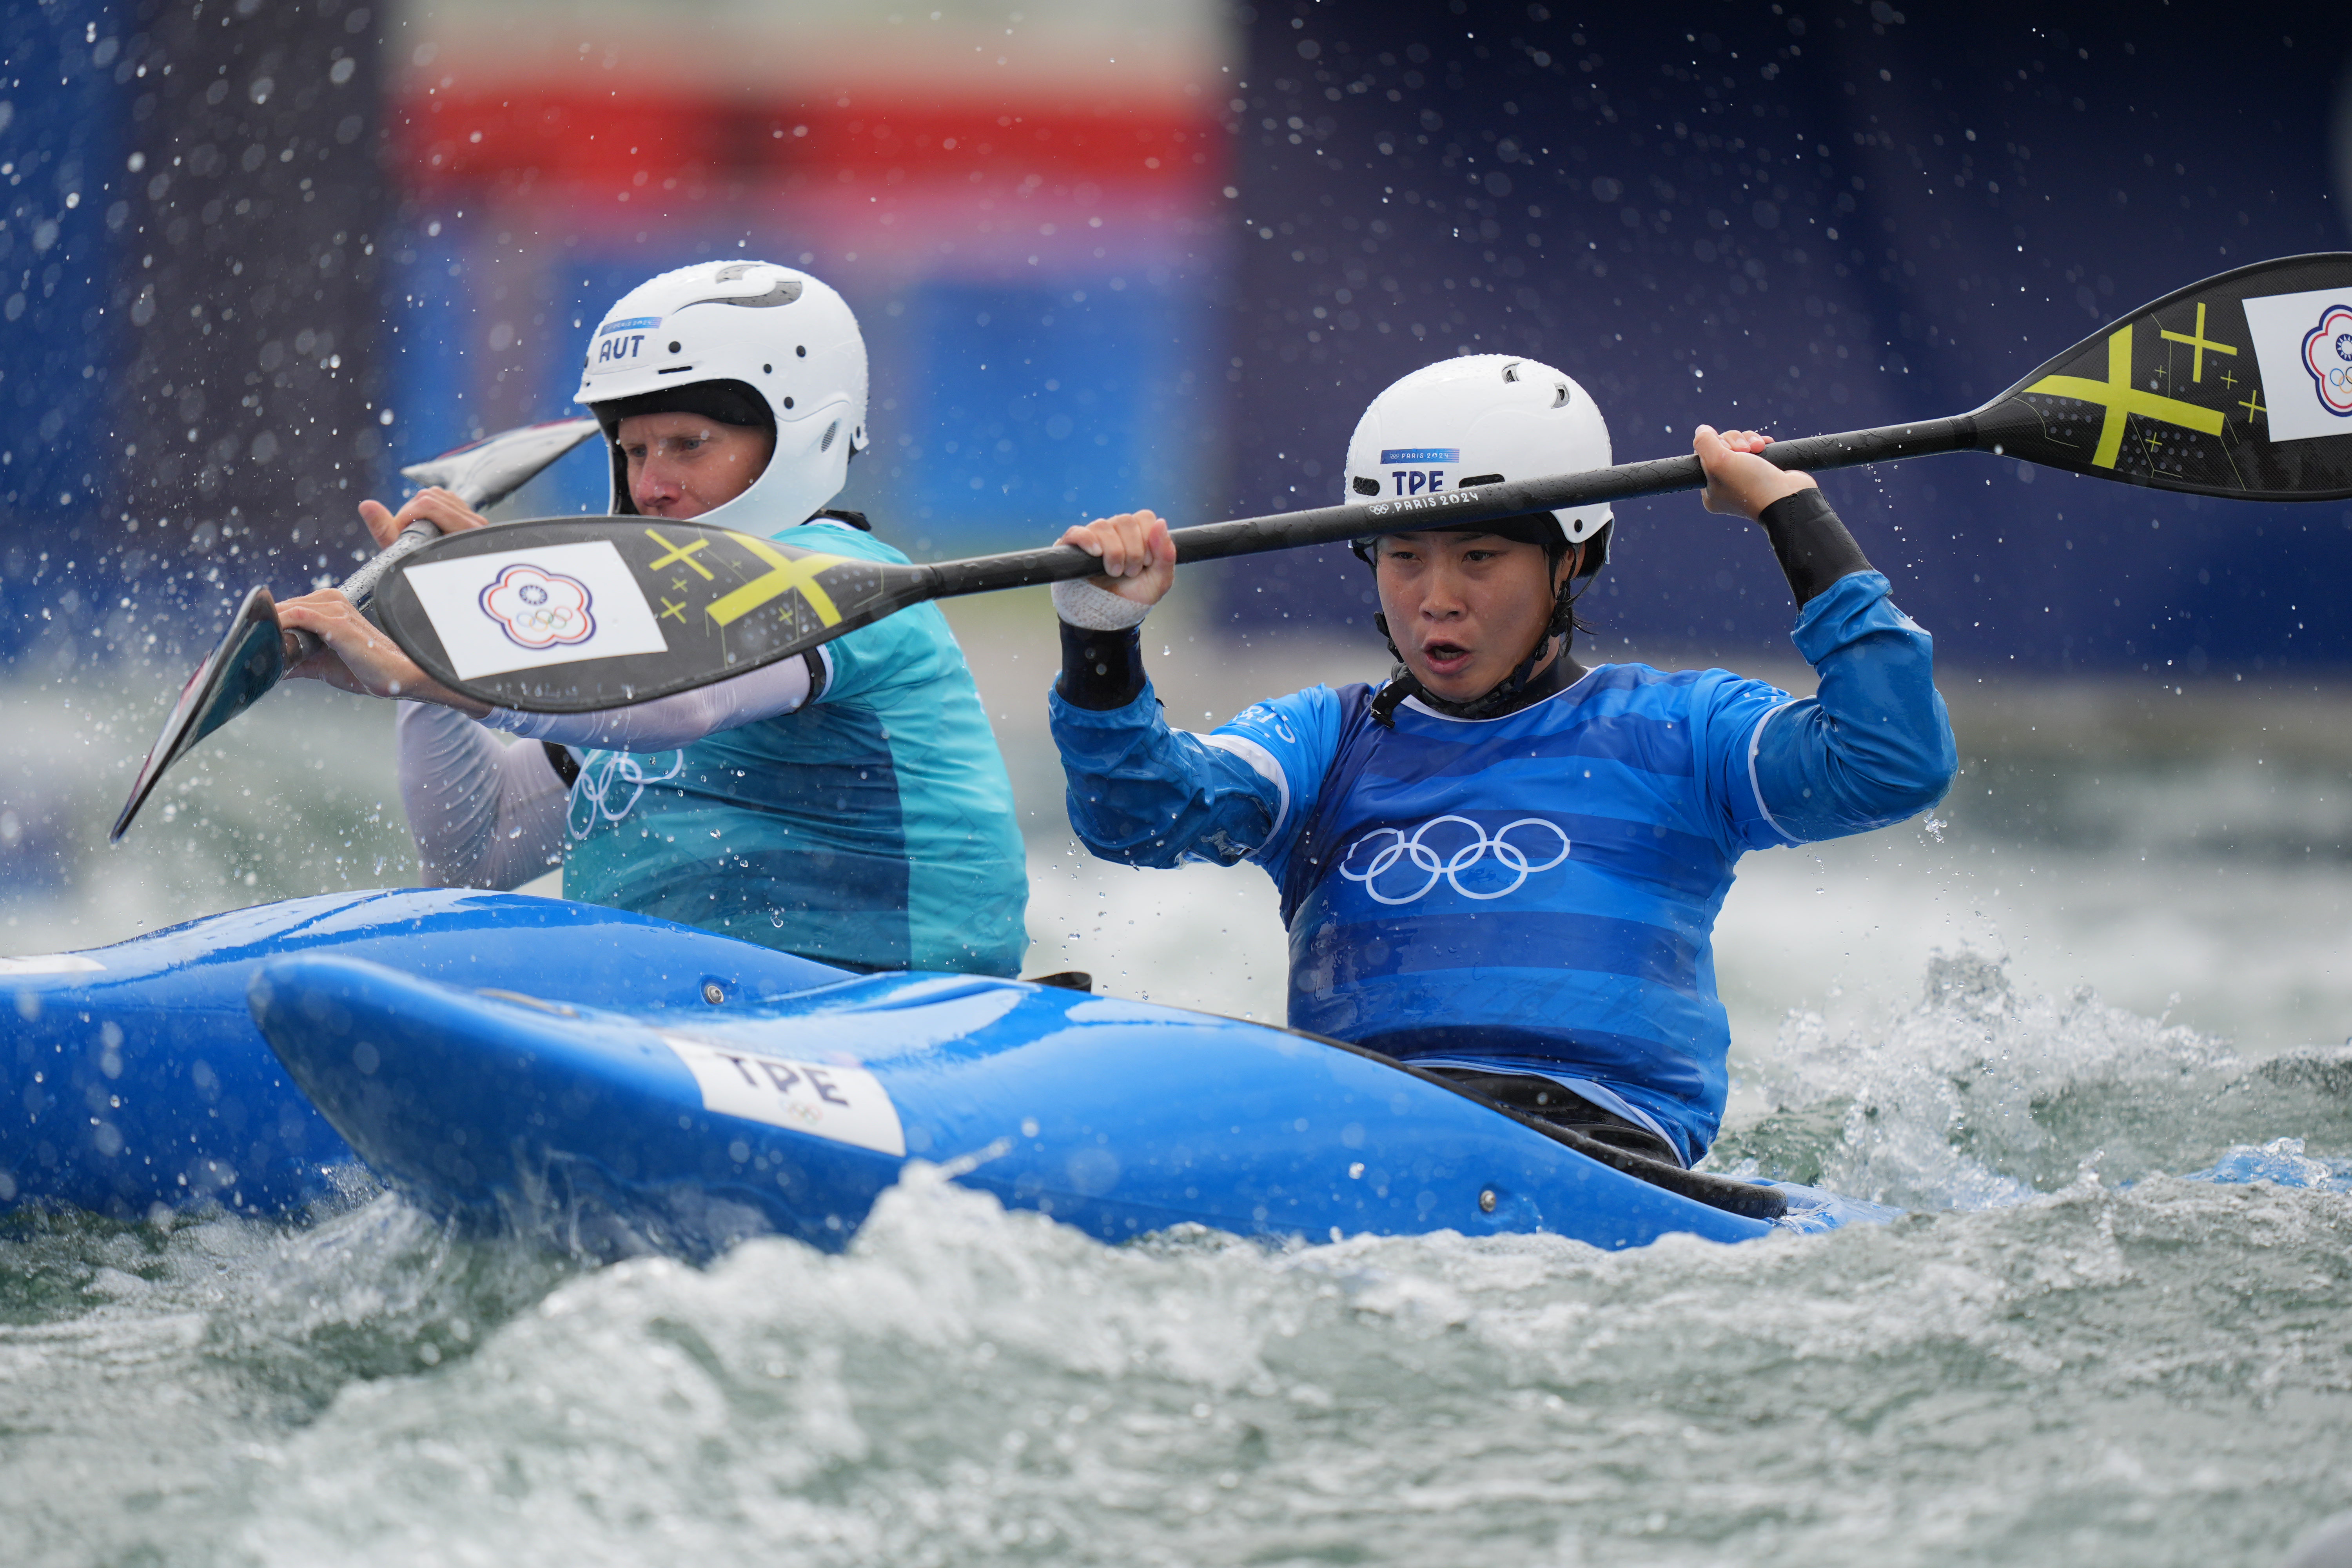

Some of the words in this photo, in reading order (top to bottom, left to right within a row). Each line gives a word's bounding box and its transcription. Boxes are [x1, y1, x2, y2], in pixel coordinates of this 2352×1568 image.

[599, 335, 645, 363] AUT
[1392, 471, 1443, 495] TPE
[1394, 497, 1436, 512] PARIS
[1439, 492, 1479, 506] 2024
[714, 1053, 849, 1107] TPE
